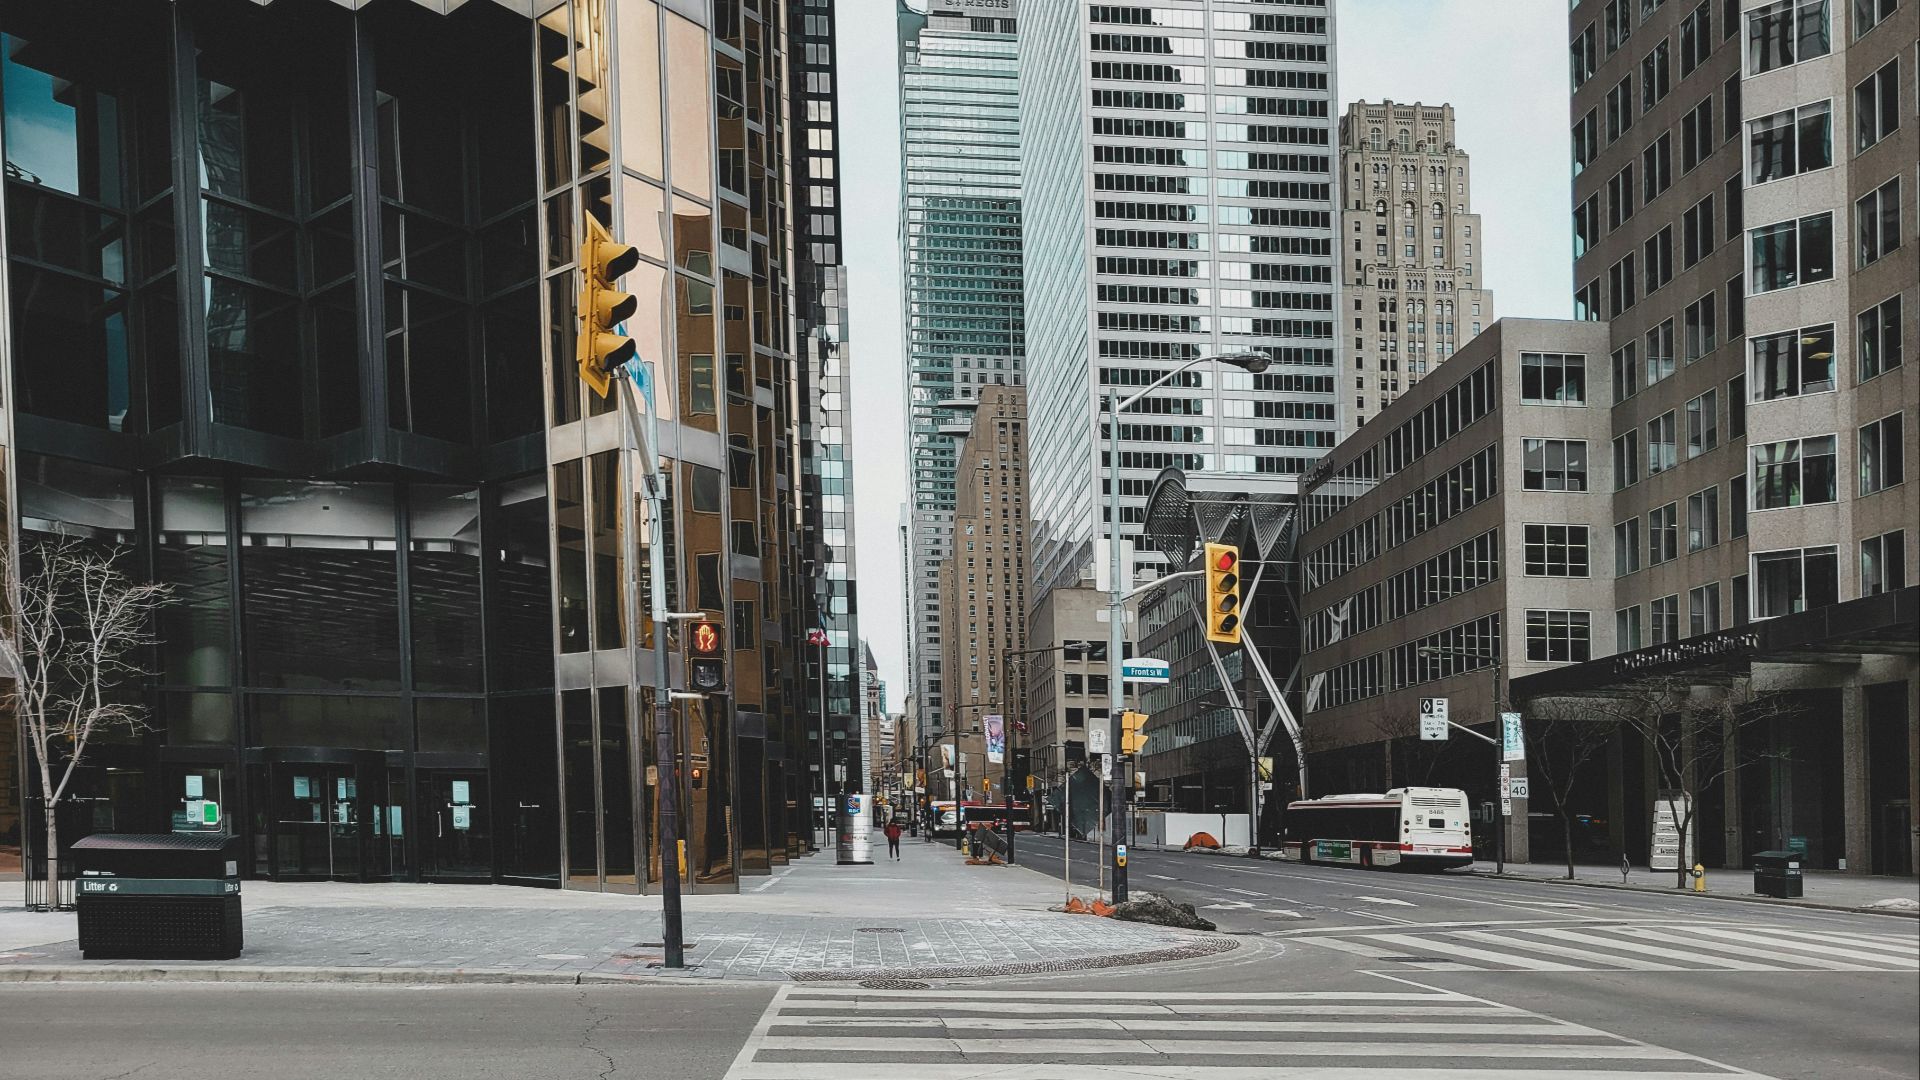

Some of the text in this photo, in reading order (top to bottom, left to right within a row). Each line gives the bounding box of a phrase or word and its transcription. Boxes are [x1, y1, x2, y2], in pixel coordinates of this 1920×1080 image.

[1131, 667, 1149, 676] Front
[1156, 668, 1163, 676] W
[1512, 786, 1527, 796] 40
[84, 881, 106, 892] Litter
